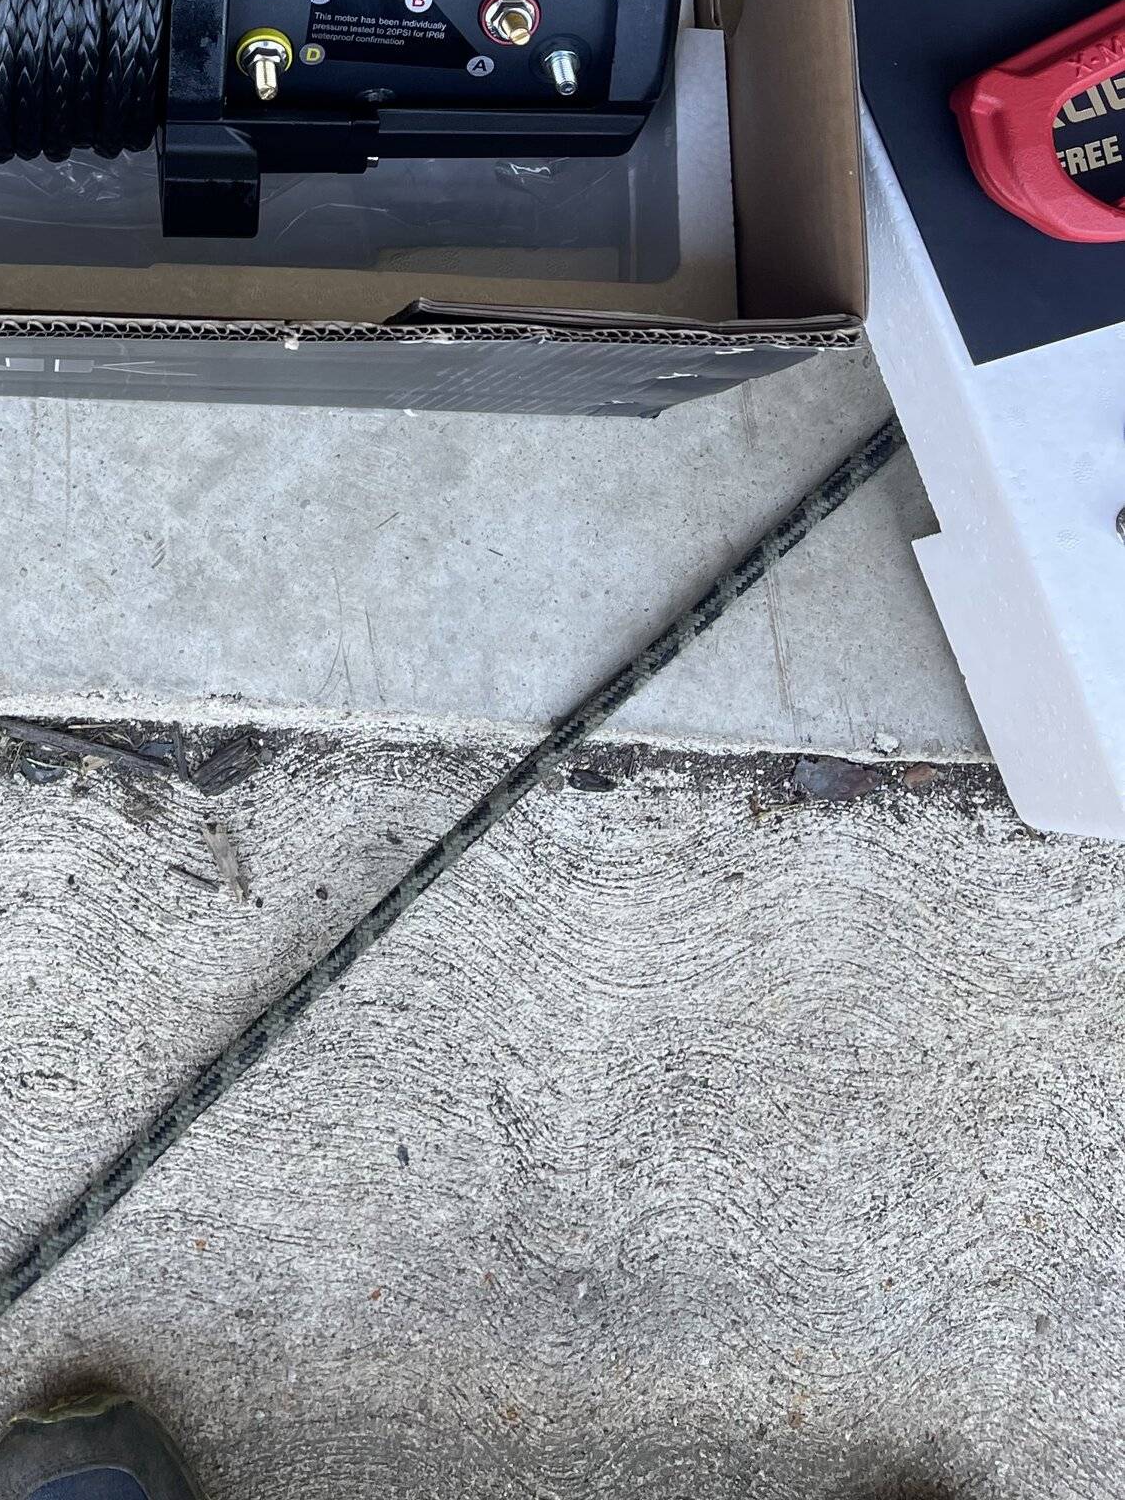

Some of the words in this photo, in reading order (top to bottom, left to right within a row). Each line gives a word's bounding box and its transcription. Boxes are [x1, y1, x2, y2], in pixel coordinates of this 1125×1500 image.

[315, 11, 332, 21] This
[334, 14, 359, 23] motor
[361, 15, 376, 24] has
[379, 17, 400, 26] been
[402, 19, 447, 32] individually
[312, 23, 349, 32] pressure
[350, 26, 375, 34] tested
[376, 27, 385, 35] to
[386, 28, 412, 37] 20PSI
[413, 30, 425, 38] for
[426, 31, 446, 40] IP68
[311, 32, 356, 42] waterproof
[355, 36, 406, 46] confirmation
[306, 48, 321, 61] D
[472, 58, 488, 72] A
